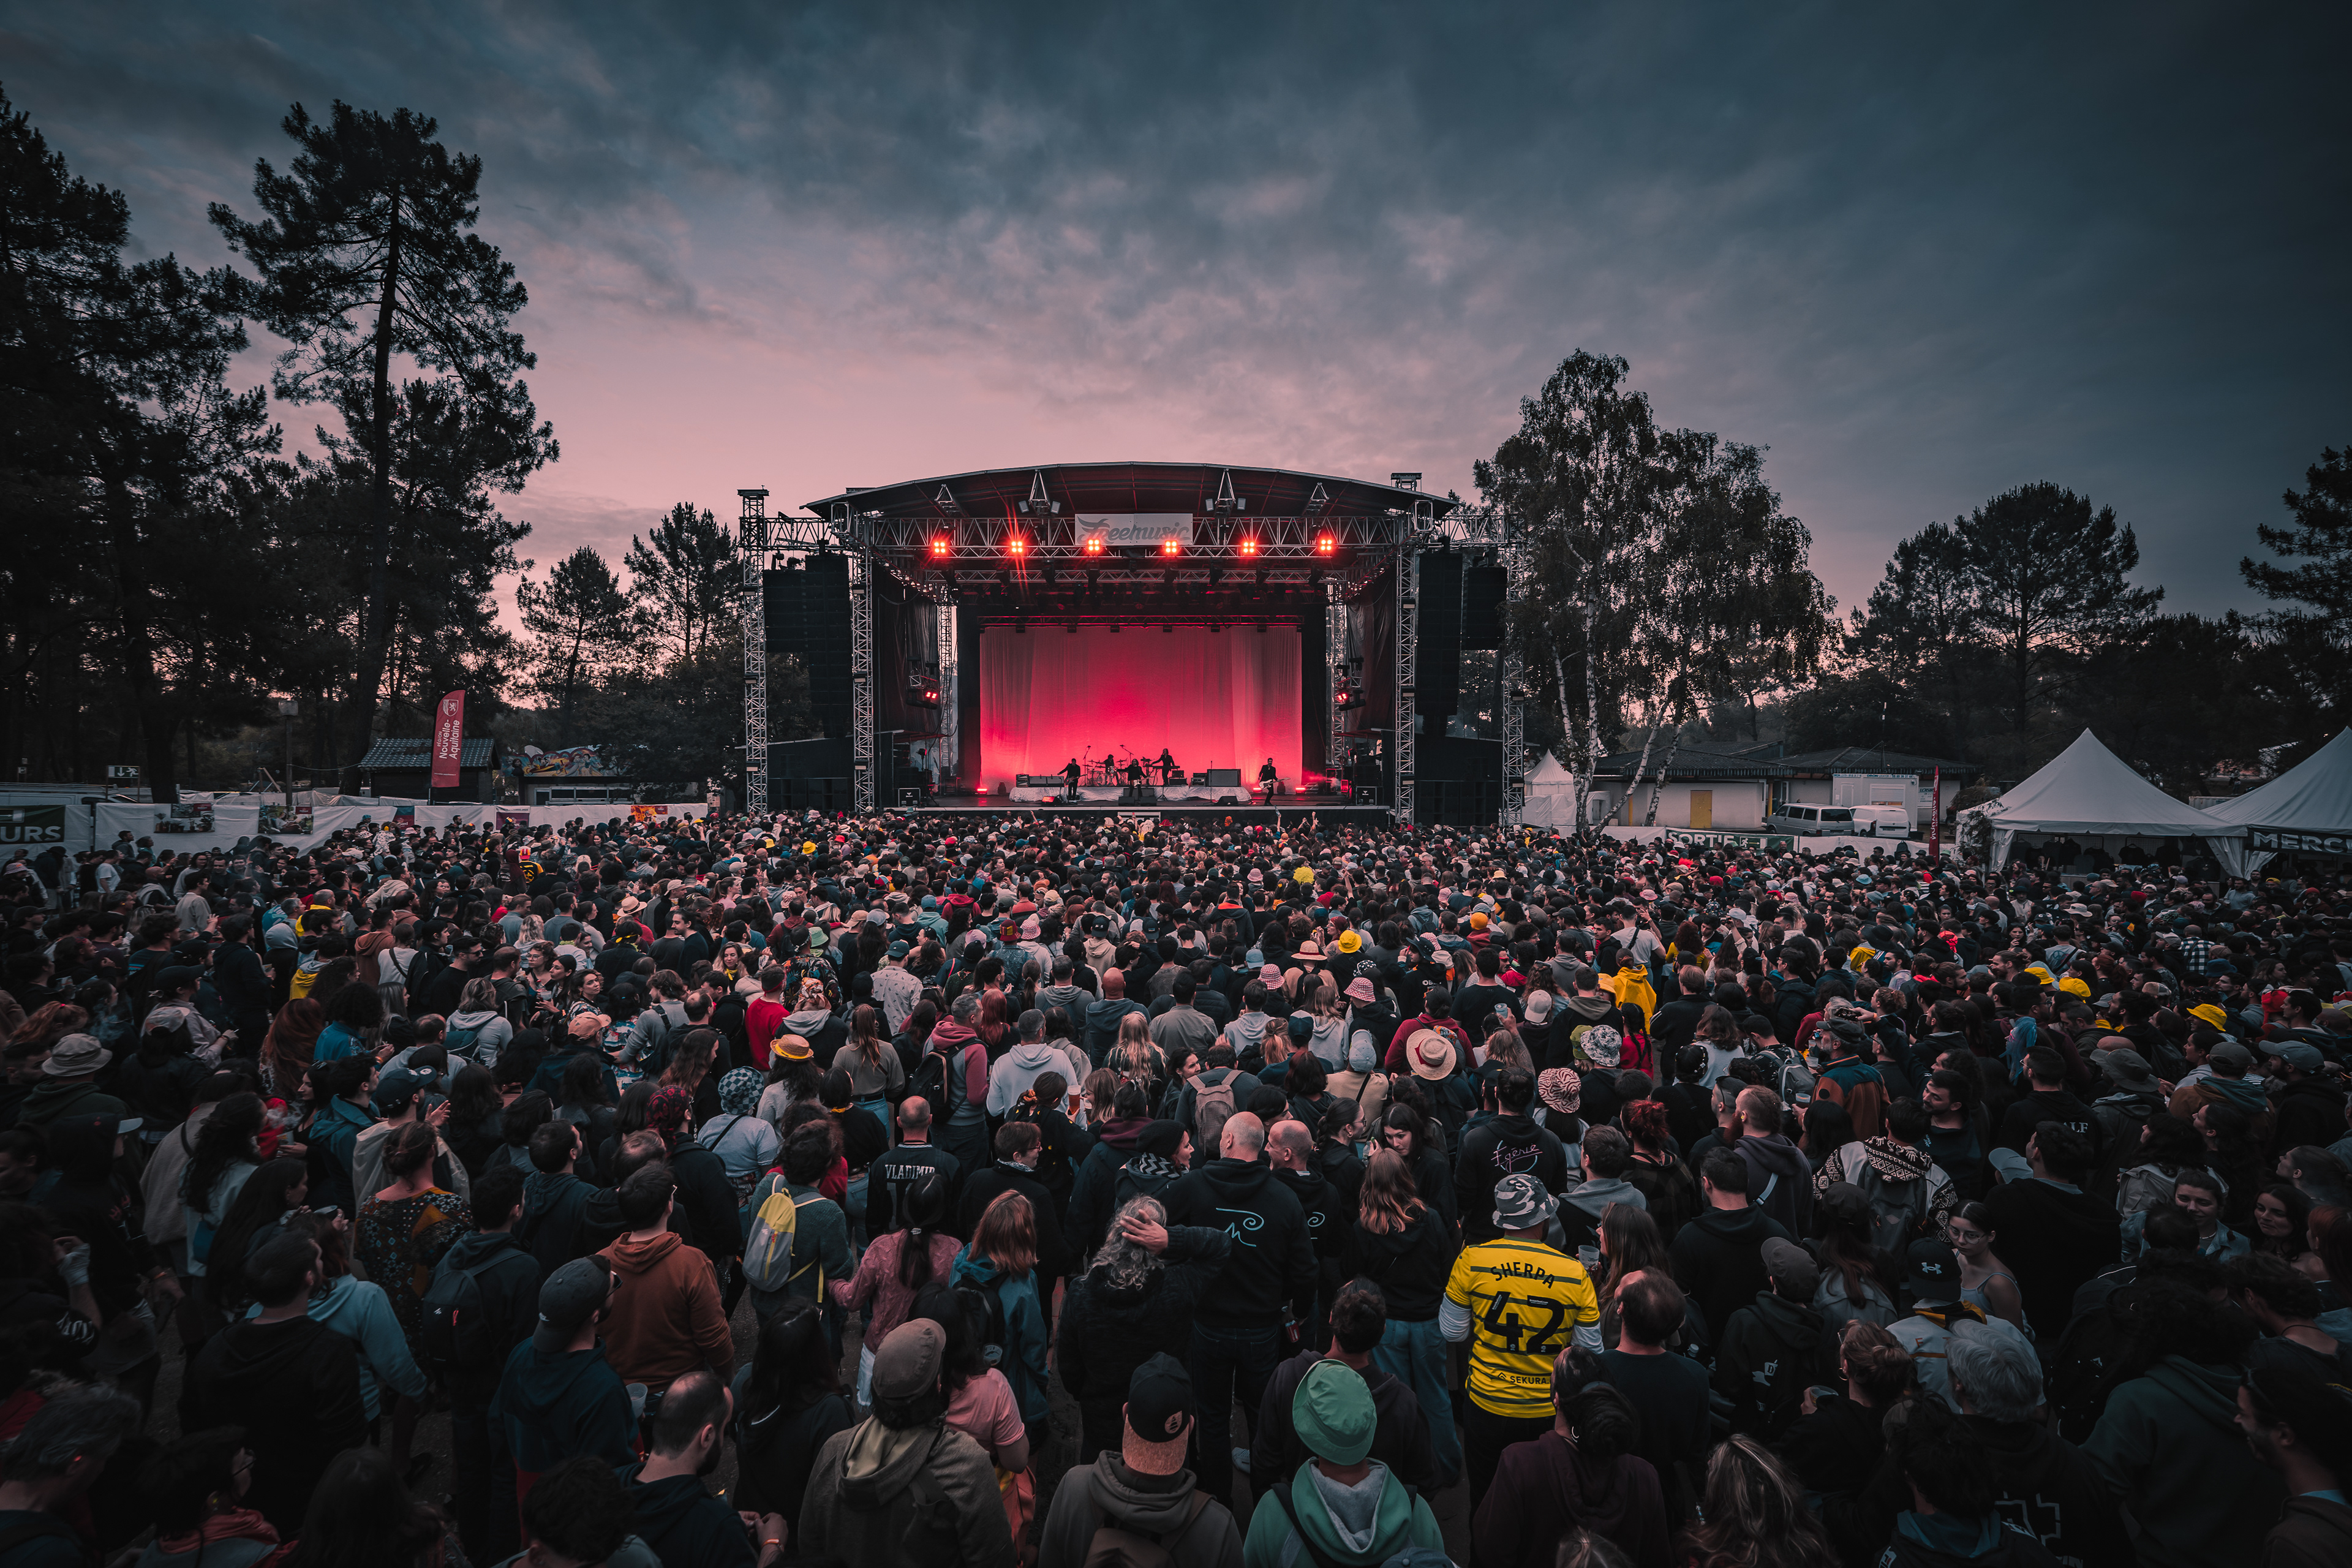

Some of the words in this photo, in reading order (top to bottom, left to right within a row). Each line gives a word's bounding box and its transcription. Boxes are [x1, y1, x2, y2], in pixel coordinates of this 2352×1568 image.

[439, 719, 451, 759] Nouvelle-
[448, 720, 460, 760] Aquitaine
[1668, 832, 1735, 848] SORTIE
[1490, 1262, 1555, 1289] SHERPA
[1484, 1291, 1565, 1354] 42
[1510, 1376, 1551, 1384] SEKURA.
